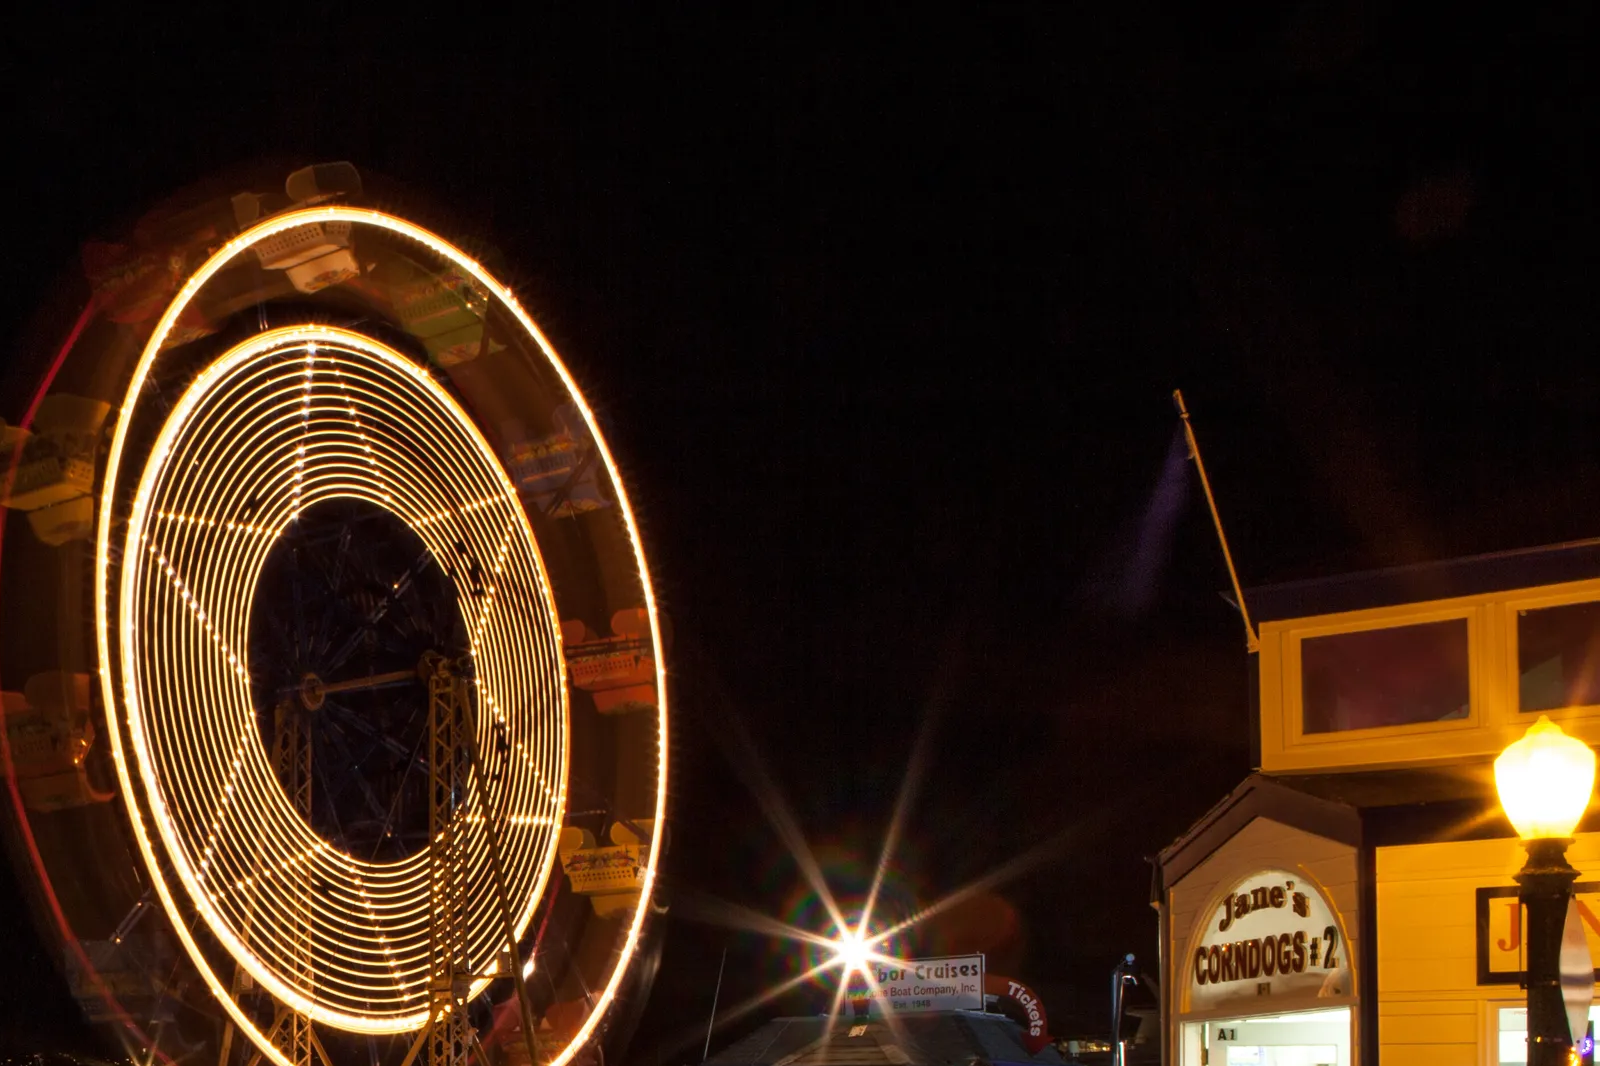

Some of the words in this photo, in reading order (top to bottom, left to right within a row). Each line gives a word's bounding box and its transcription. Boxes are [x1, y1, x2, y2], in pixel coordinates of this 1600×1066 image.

[1218, 880, 1311, 932] Jane's
[915, 963, 979, 980] Cruises
[1194, 930, 1308, 986] CORNDOGS
[890, 986, 912, 997] Boat
[960, 982, 978, 994] Inc.
[1008, 980, 1044, 1036] Tickets
